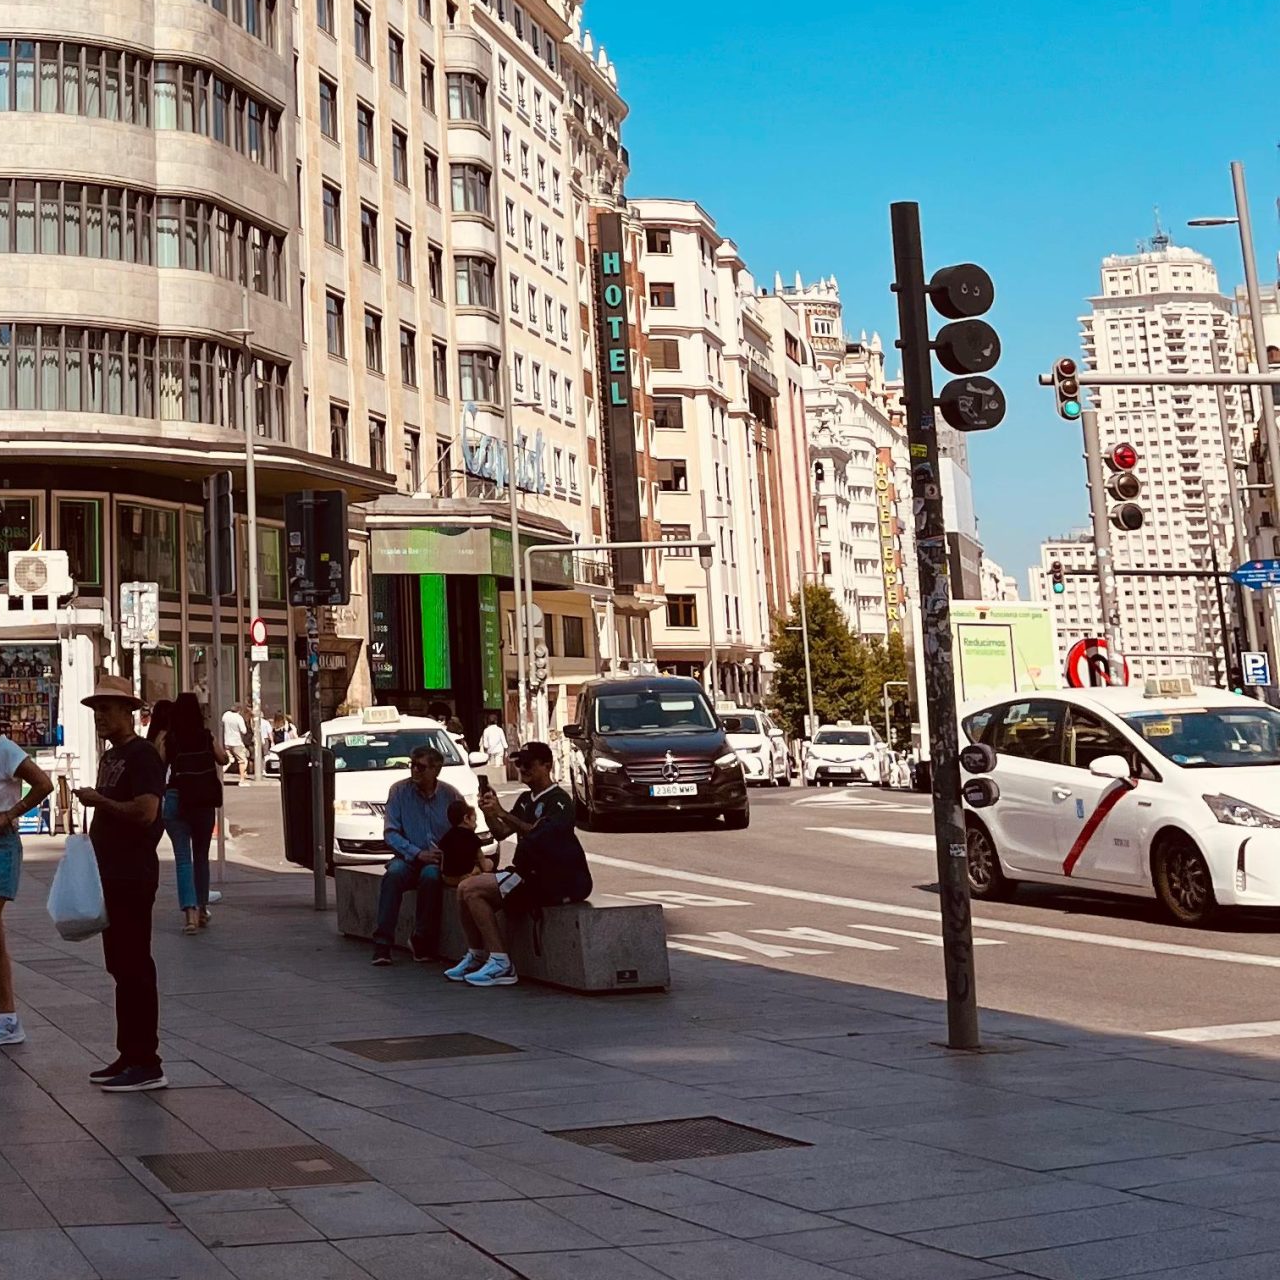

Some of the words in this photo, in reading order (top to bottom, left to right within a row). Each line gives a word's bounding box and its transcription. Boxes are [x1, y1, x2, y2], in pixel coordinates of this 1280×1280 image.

[603, 251, 628, 406] HOTEL
[875, 461, 893, 539] HOTEL
[883, 546, 901, 634] EMPERA
[963, 637, 1007, 647] Reducimos
[1245, 654, 1265, 676] P
[347, 735, 367, 746] LIBRE
